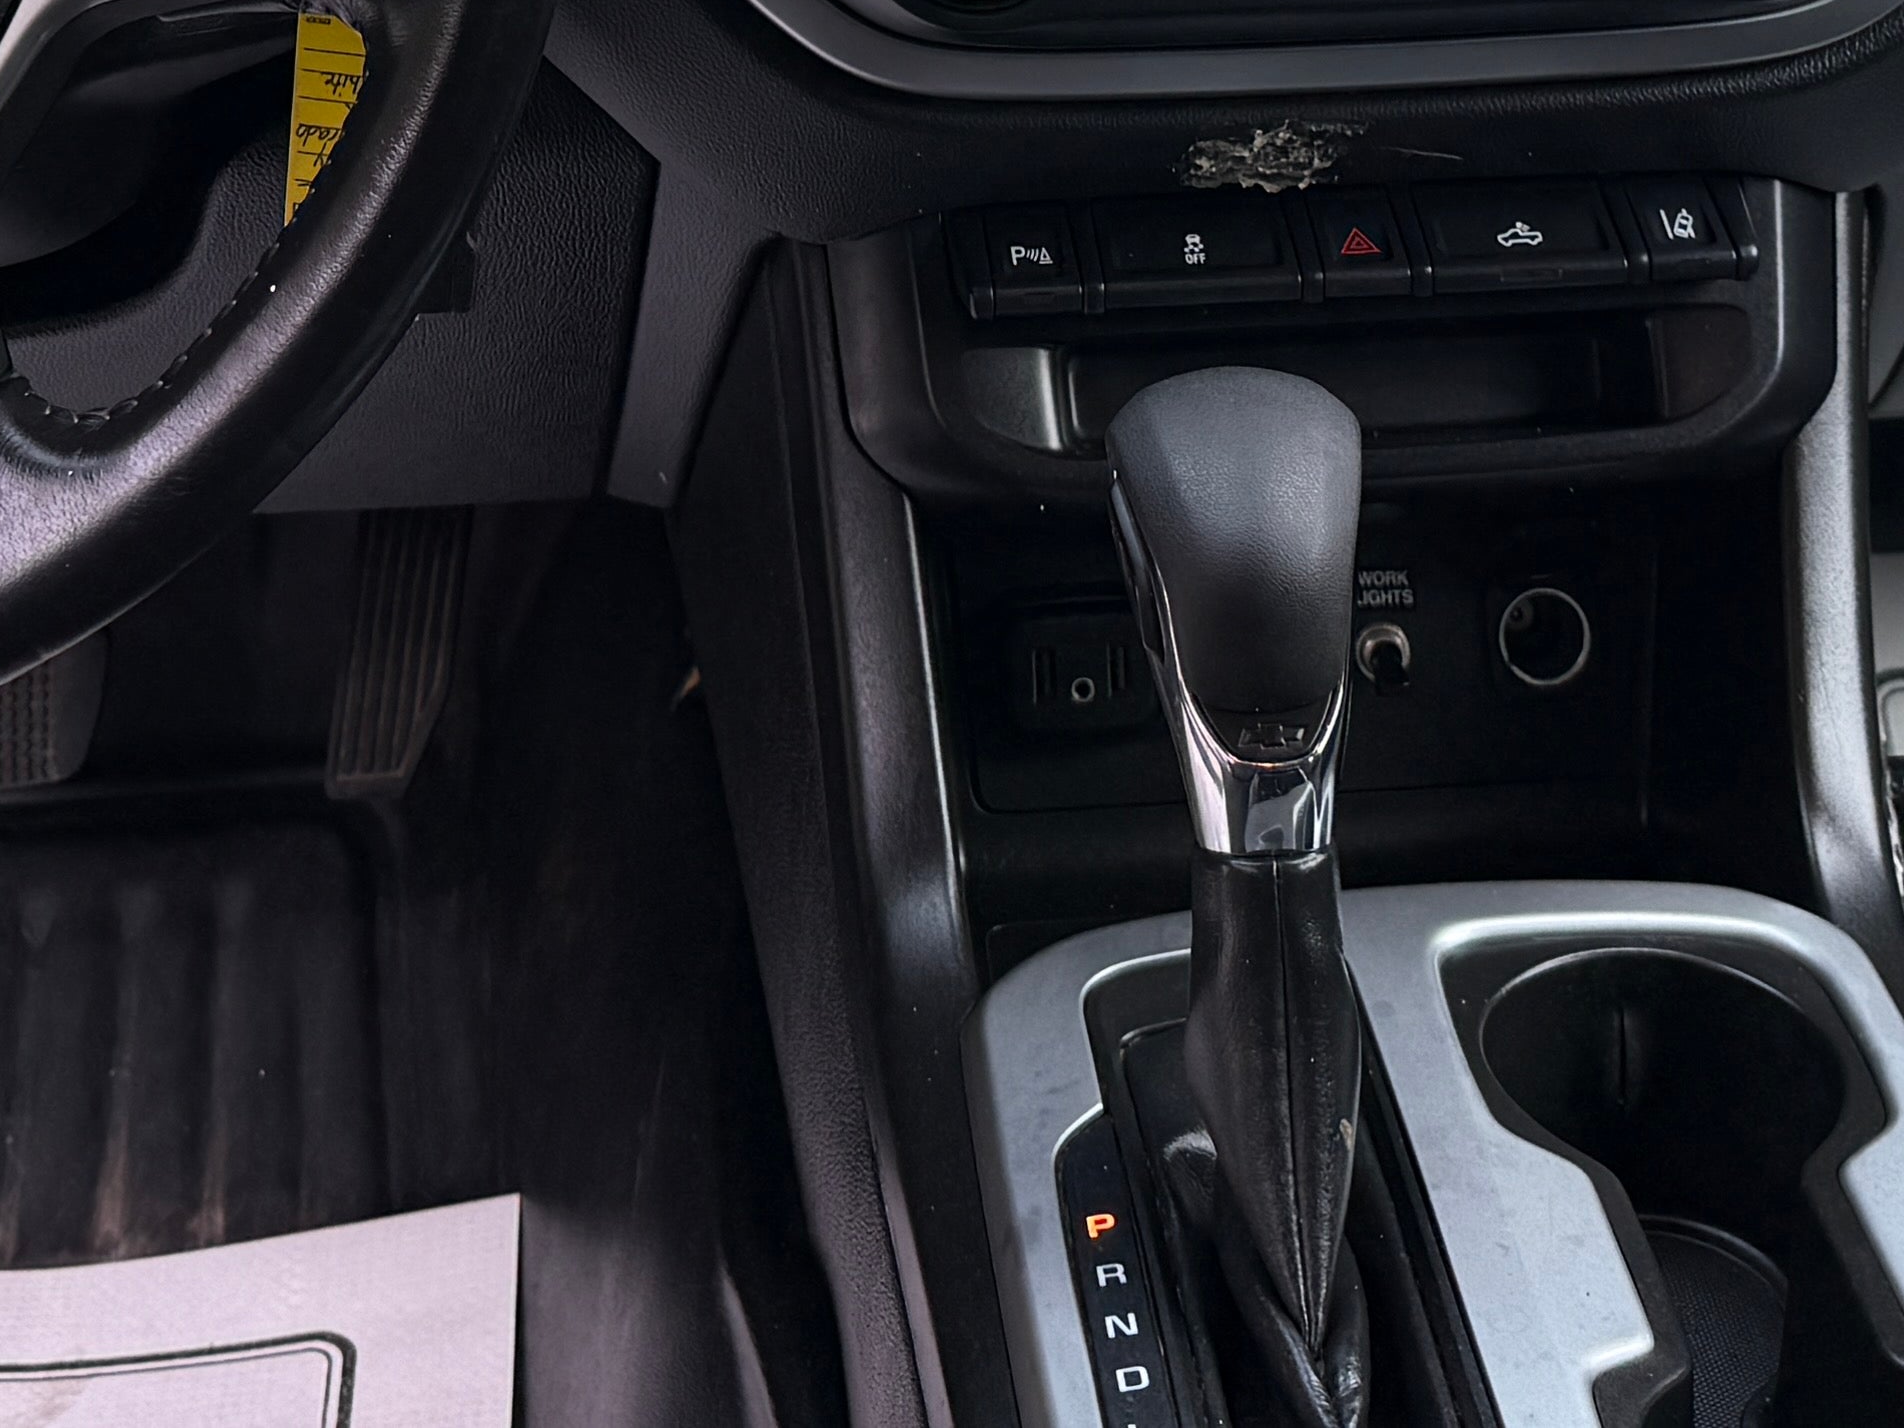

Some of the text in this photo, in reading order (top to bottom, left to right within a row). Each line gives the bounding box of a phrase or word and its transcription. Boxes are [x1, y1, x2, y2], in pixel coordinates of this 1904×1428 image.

[1185, 252, 1207, 265] OFF
[1358, 570, 1410, 587] WORK
[1085, 1213, 1116, 1239] P
[1095, 1263, 1128, 1287] R
[1104, 1312, 1139, 1339] N
[1114, 1365, 1151, 1393] D
